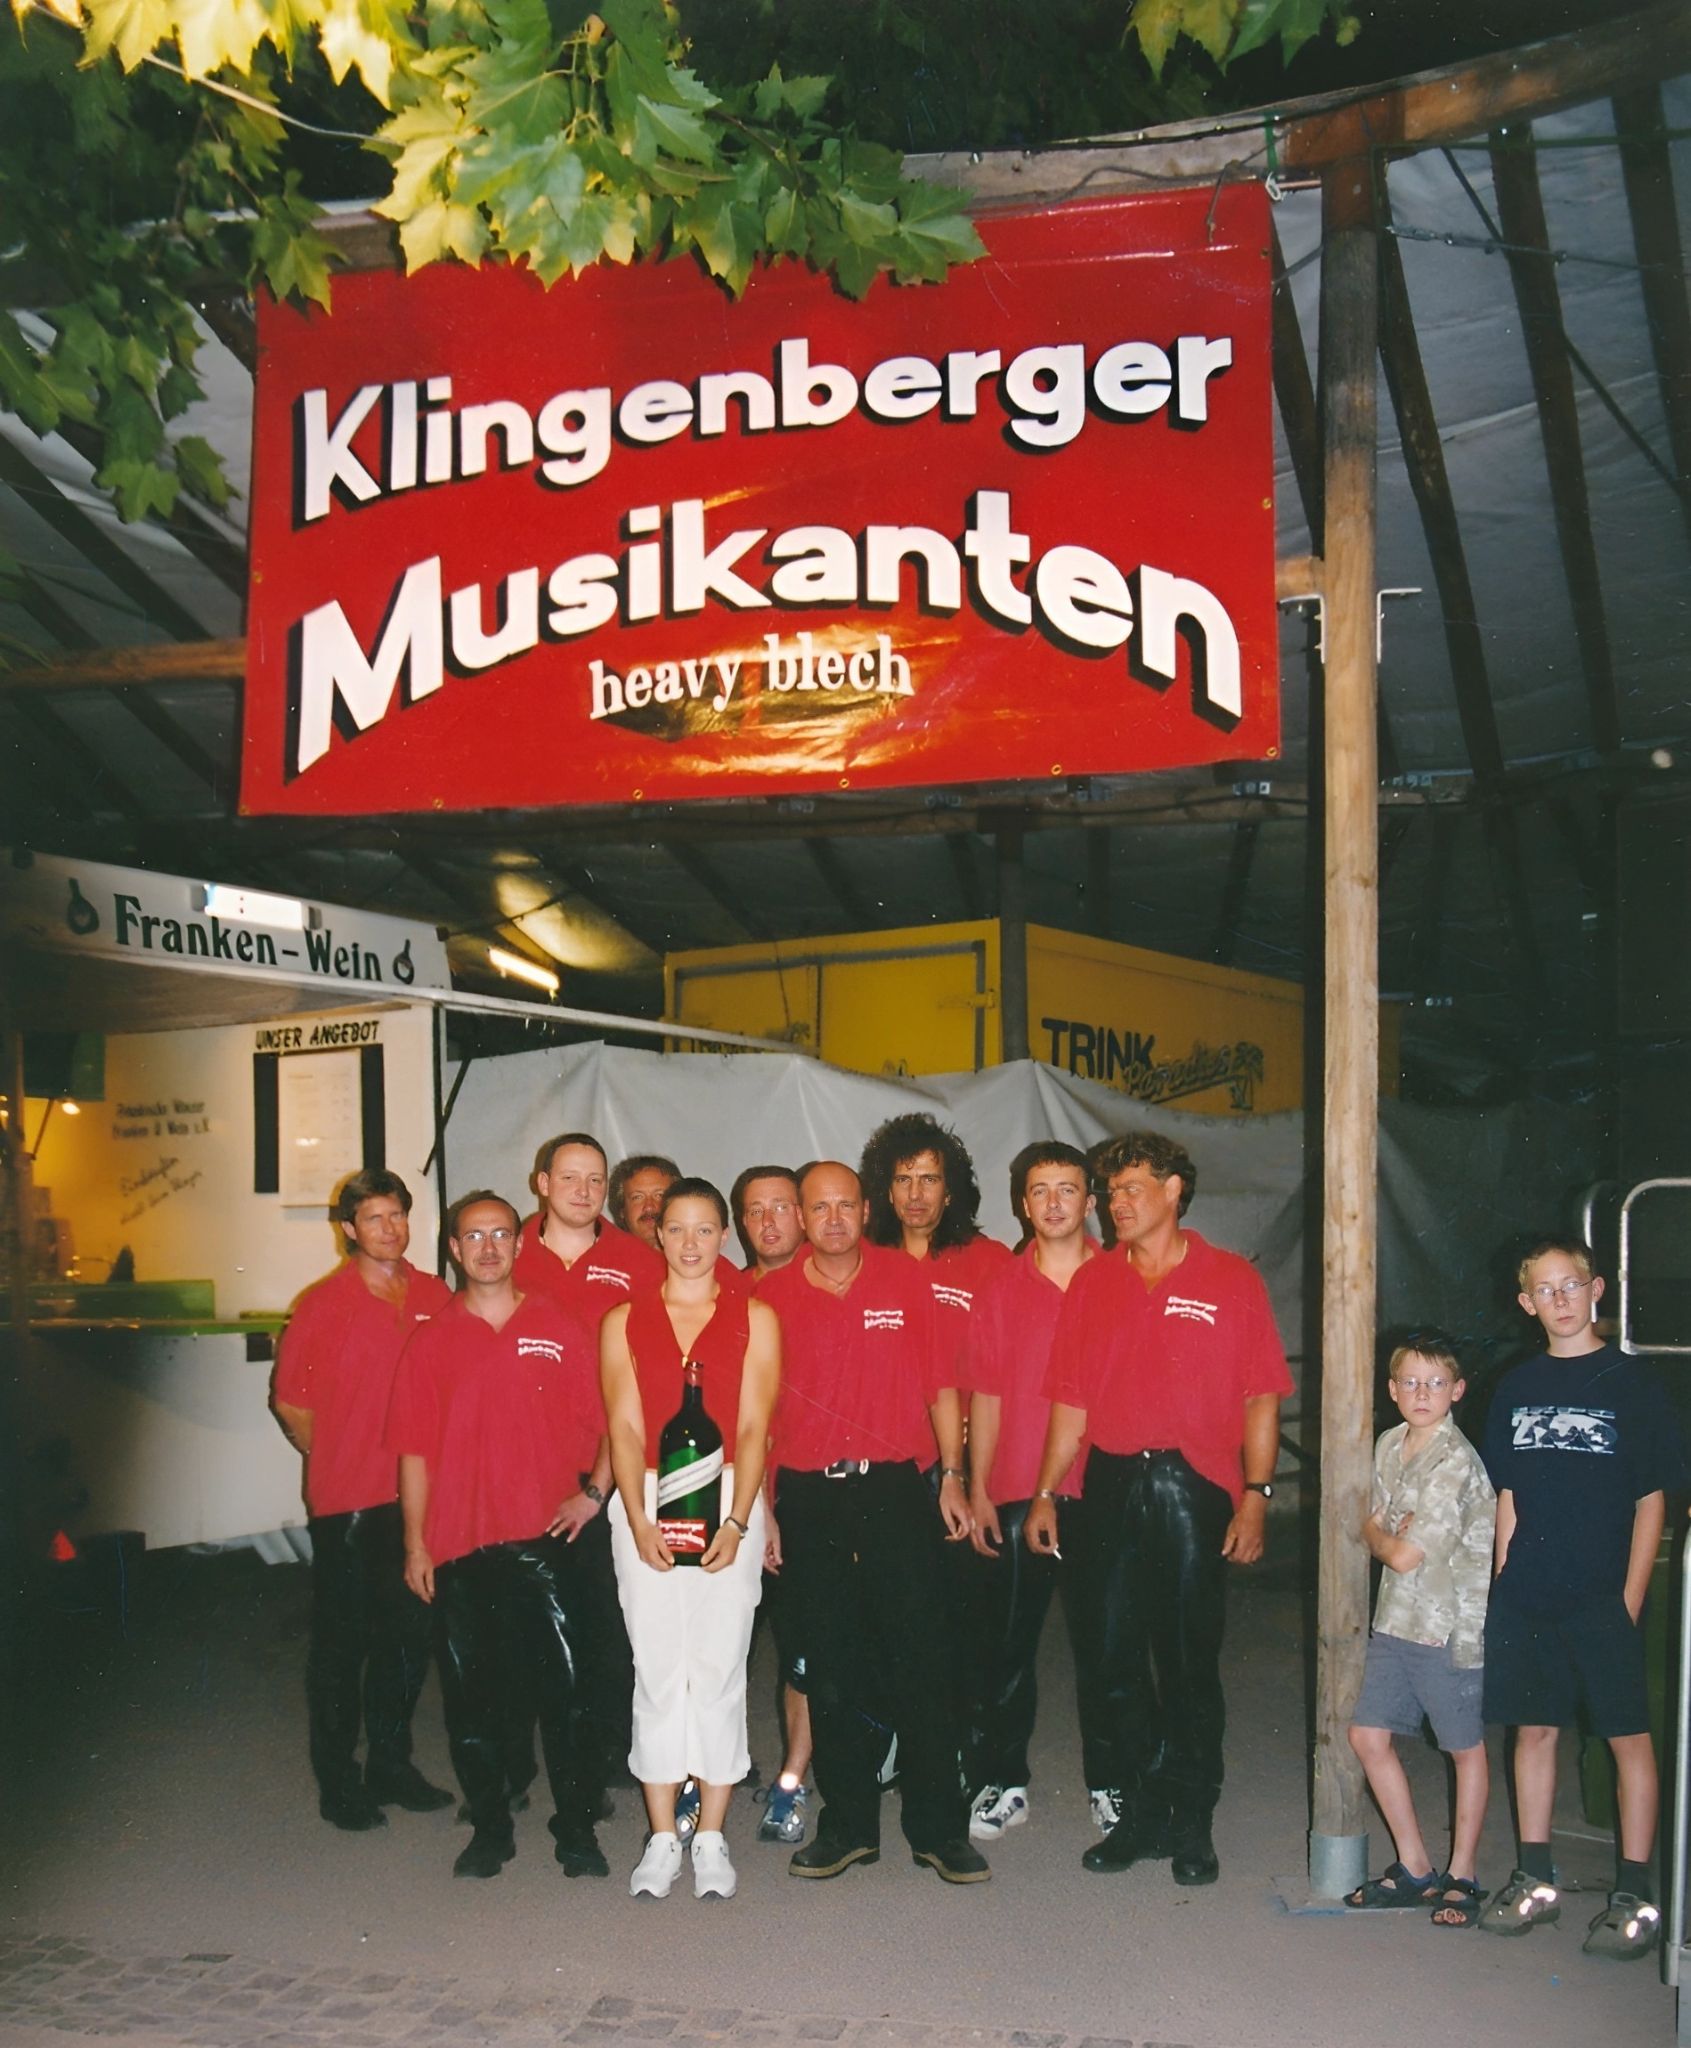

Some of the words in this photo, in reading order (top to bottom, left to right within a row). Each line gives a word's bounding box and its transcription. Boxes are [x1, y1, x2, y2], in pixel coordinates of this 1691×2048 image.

[297, 335, 1232, 526] Klingenberger
[290, 490, 1243, 775] Musikanten
[588, 654, 742, 720] heavy
[762, 631, 915, 697] blech
[113, 893, 383, 982] Franken-Wein
[255, 1027, 303, 1051] UNSER
[309, 1020, 380, 1046] ANGEBOT
[1041, 1017, 1155, 1081] TRINK
